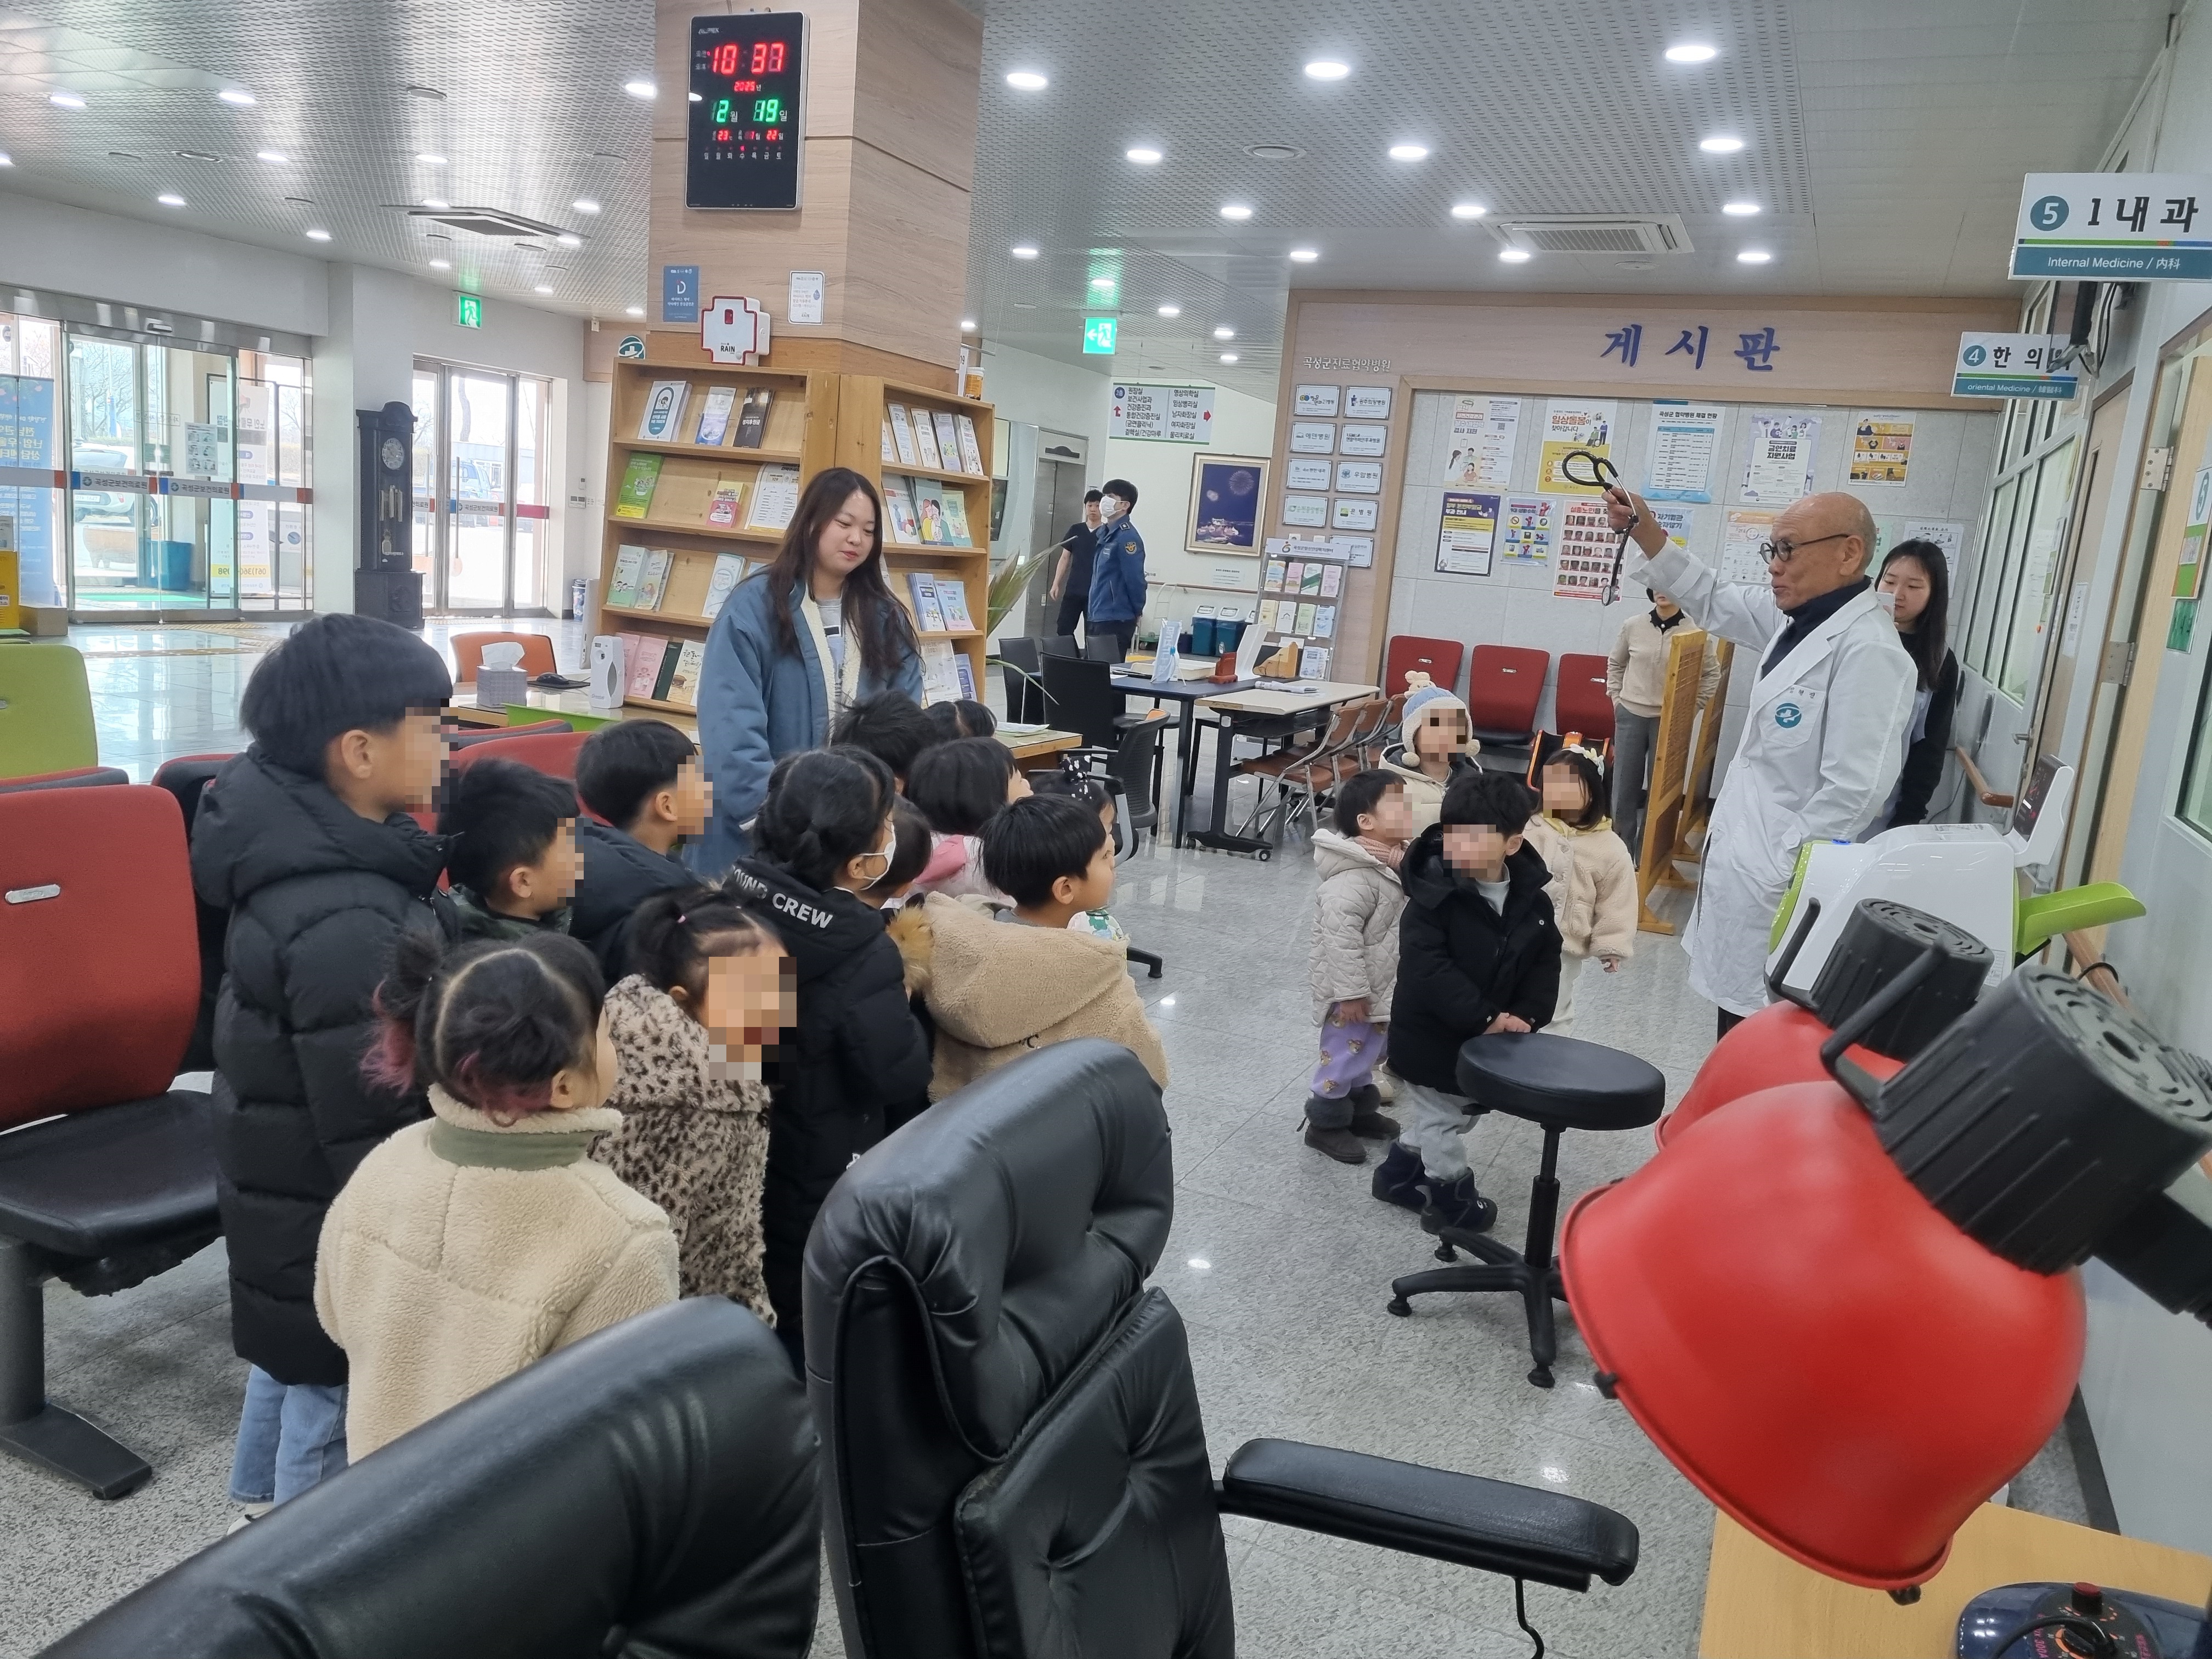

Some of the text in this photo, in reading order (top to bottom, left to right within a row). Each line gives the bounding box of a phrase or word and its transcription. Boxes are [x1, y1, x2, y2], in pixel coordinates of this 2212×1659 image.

[713, 43, 785, 75] 10 37
[2042, 202, 2059, 224] 5
[2048, 257, 2089, 268] Internal
[2092, 257, 2143, 269] Medicine
[2156, 258, 2181, 270] 内科
[1967, 348, 1979, 363] 4
[1303, 357, 1391, 373] 곡성군진료협약병원
[1173, 400, 1198, 408] 임상병리실
[1126, 412, 1161, 421] 통합건강증진실
[1172, 410, 1197, 419] 남자화장실
[1552, 415, 1592, 425] 일상돌봄이
[1171, 421, 1196, 430] 여자화장실
[1170, 431, 1195, 439] 물리치료실
[94, 478, 148, 489] 곡성군보건의료원
[182, 484, 229, 494] 곡성군보건의료원
[465, 504, 498, 512] 곡성군보건의료원
[772, 893, 833, 929] CREW
